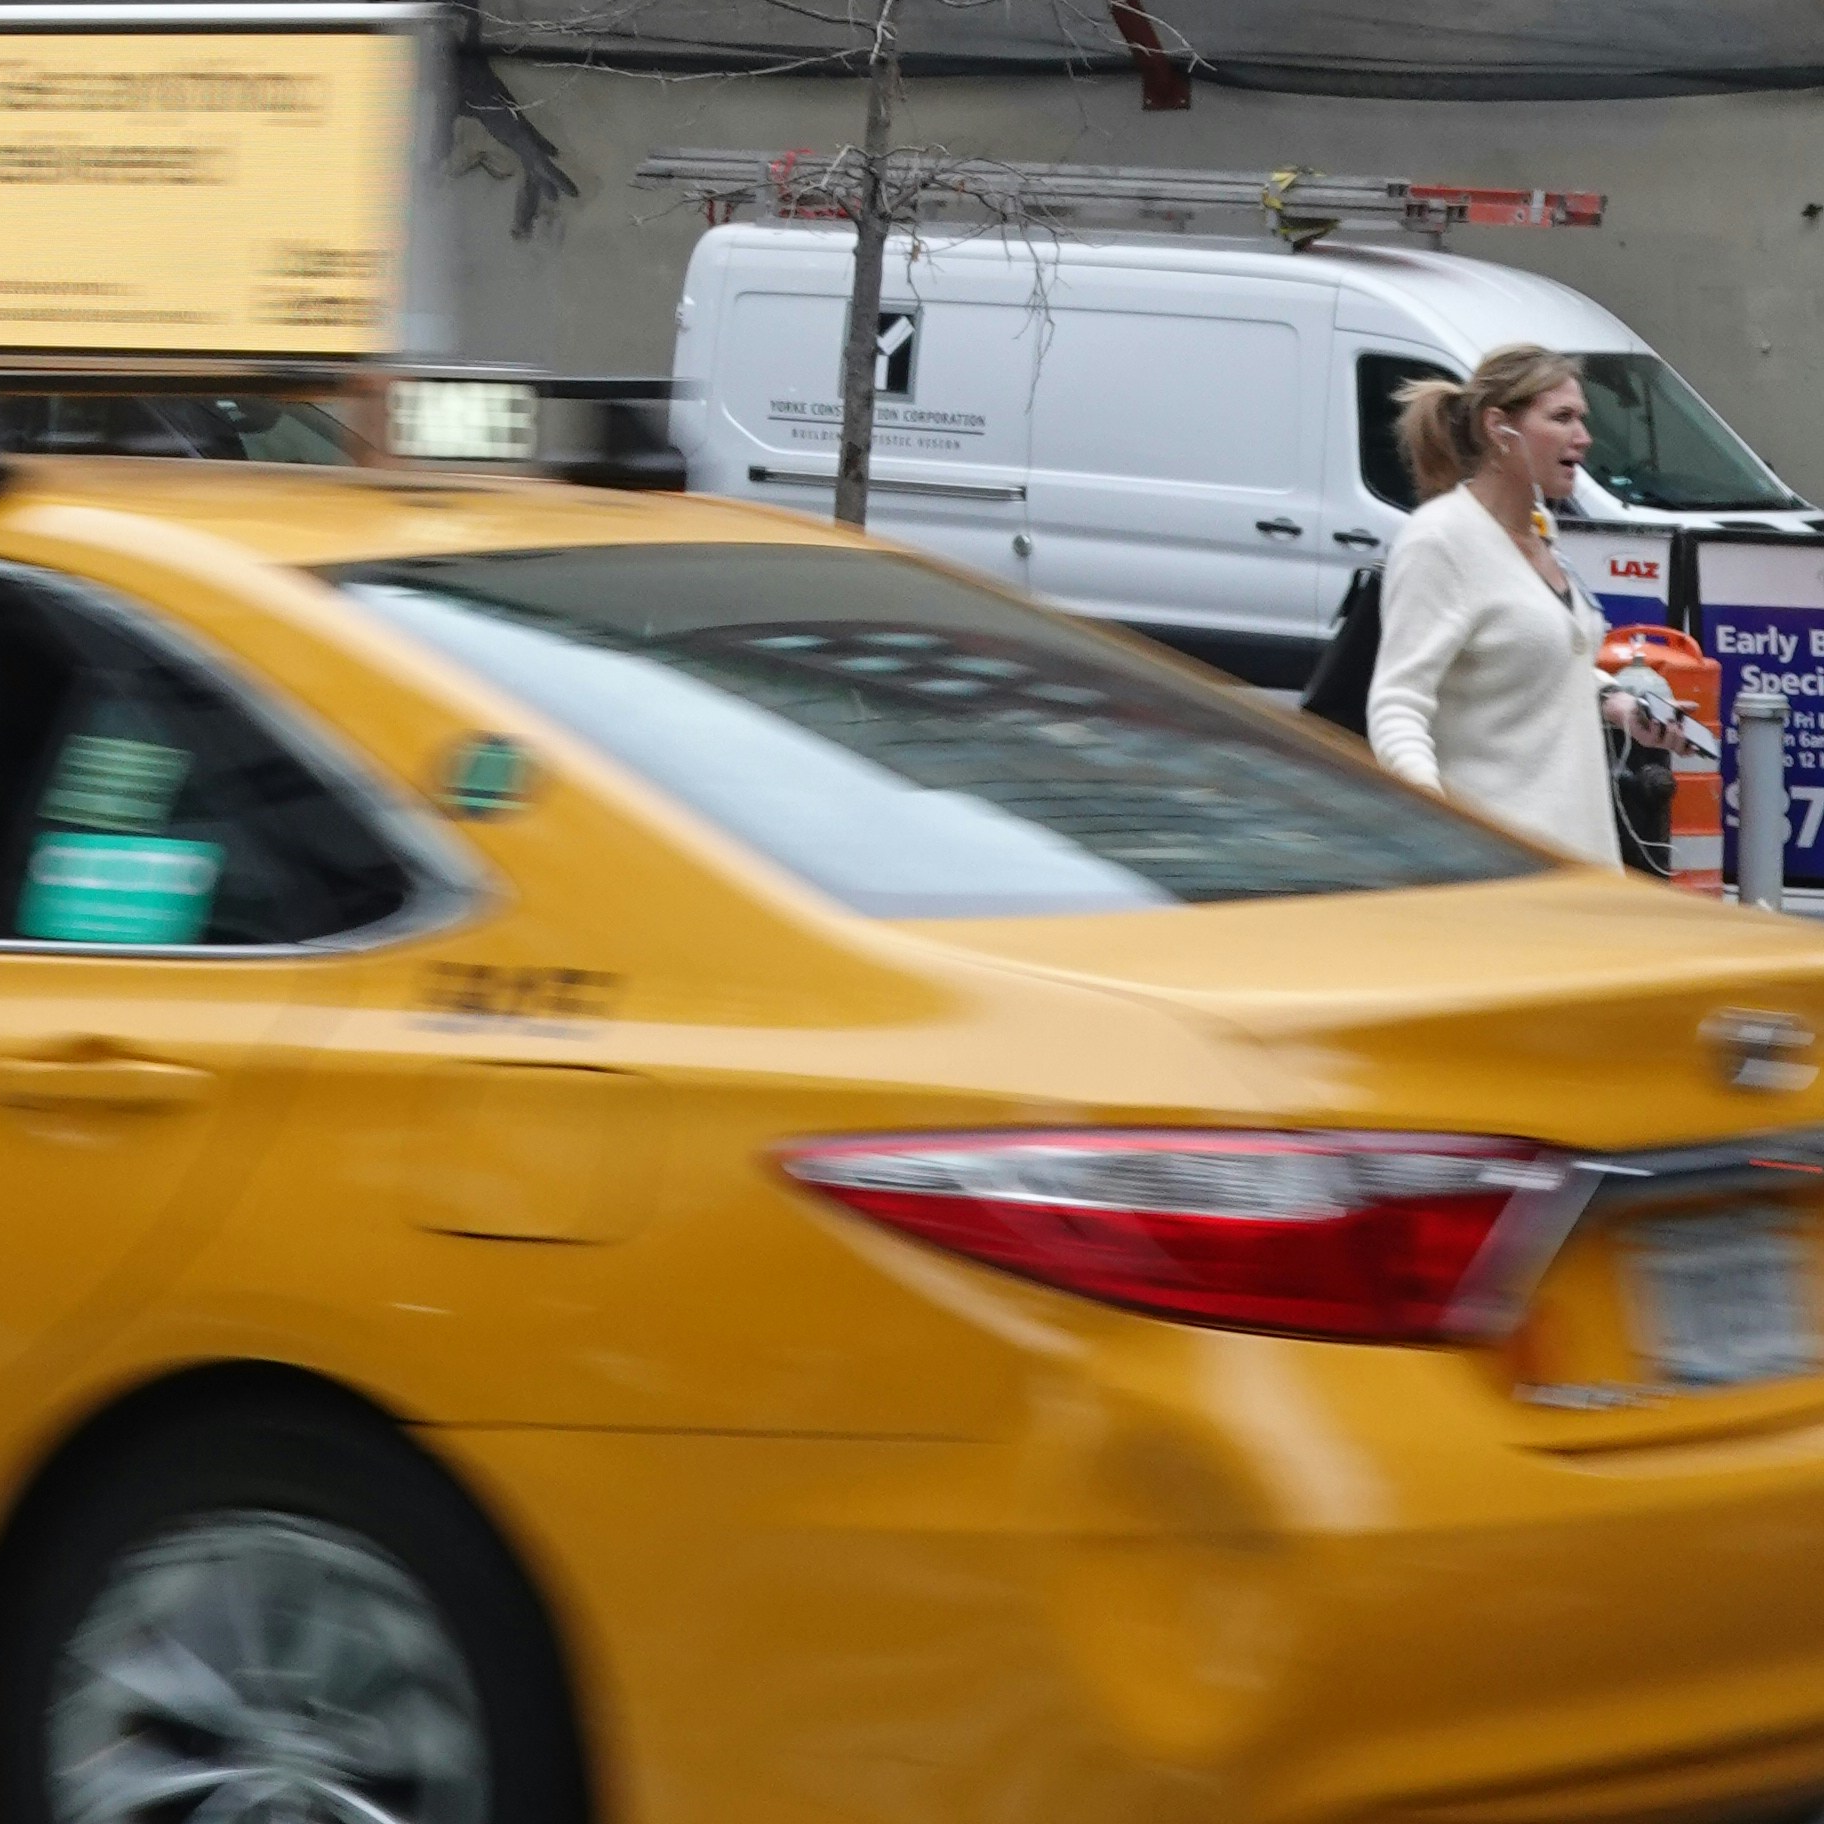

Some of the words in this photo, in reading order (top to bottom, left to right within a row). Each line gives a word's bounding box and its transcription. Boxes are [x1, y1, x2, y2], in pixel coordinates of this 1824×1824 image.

[811, 404, 898, 421] CONSION
[903, 410, 986, 427] CORPORATION
[1610, 559, 1660, 580] LAZ
[1716, 624, 1799, 664] Early
[1798, 751, 1816, 769] 12
